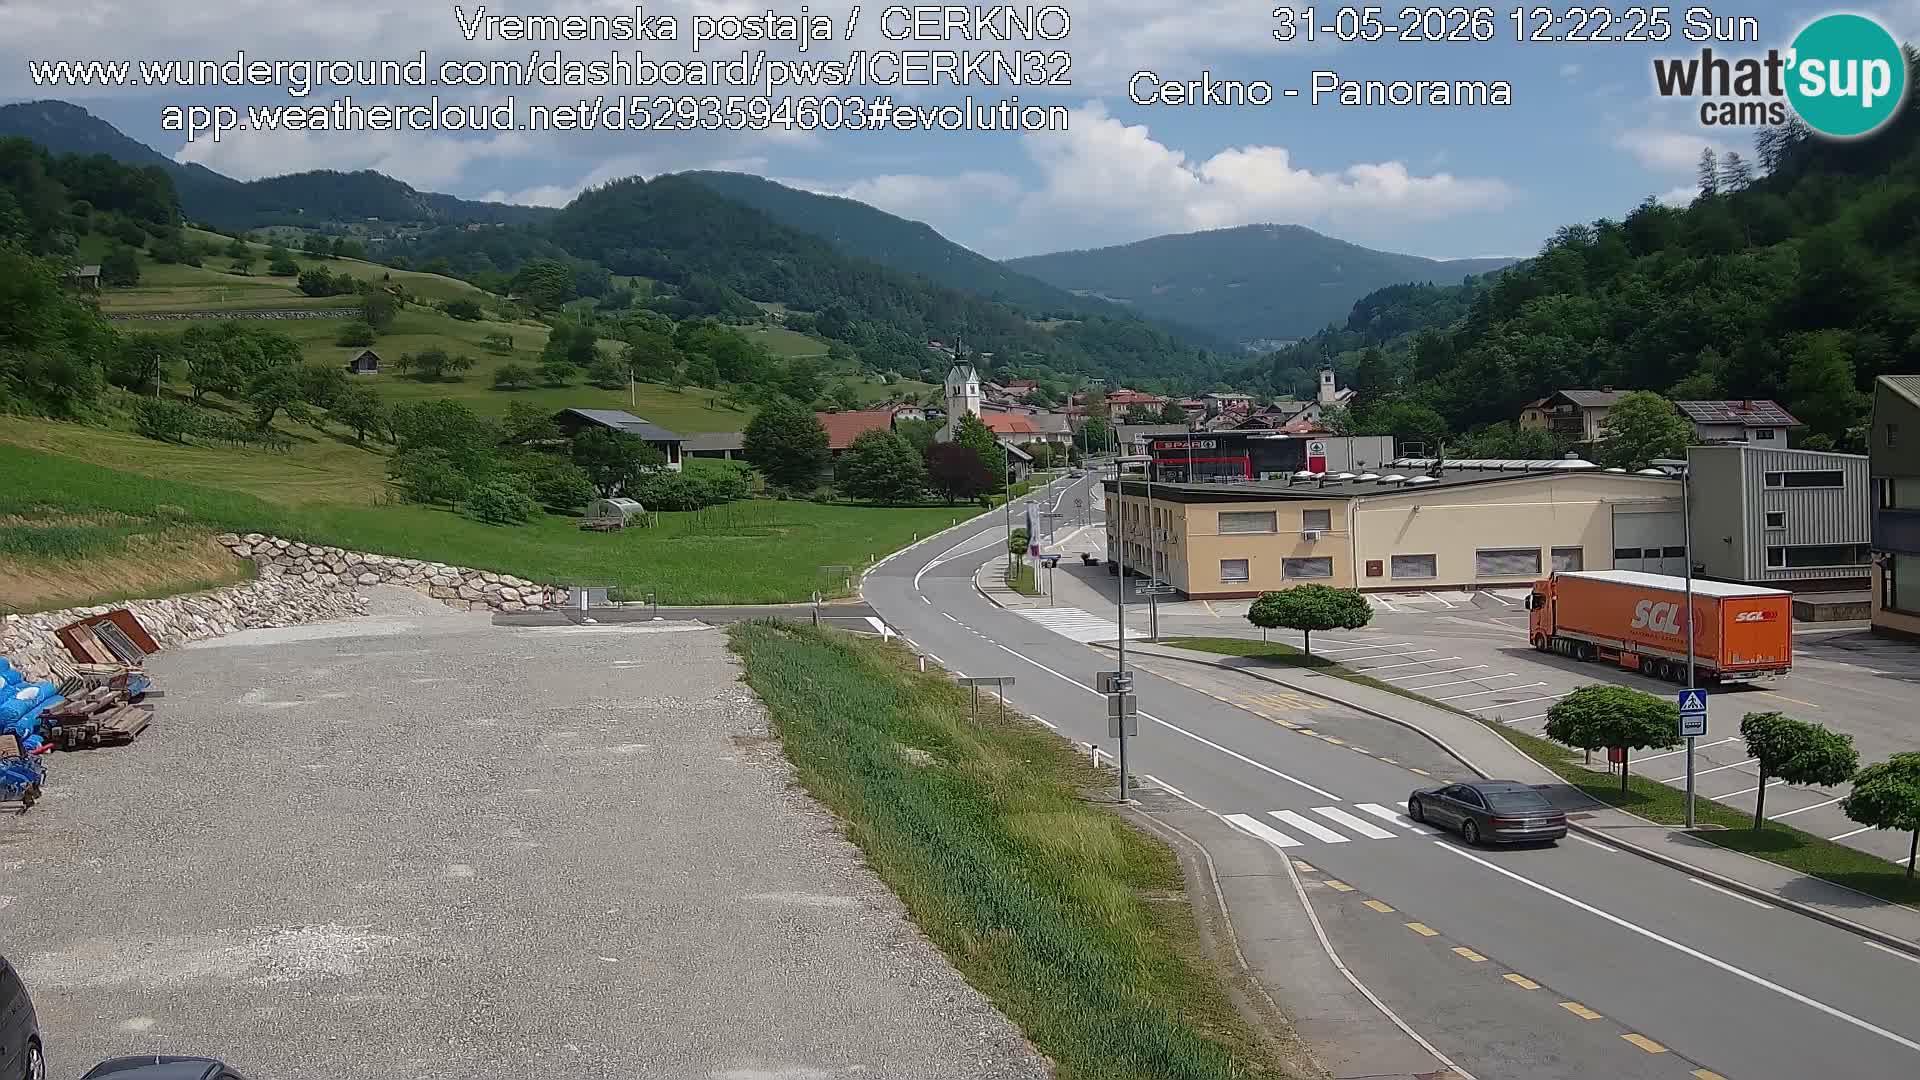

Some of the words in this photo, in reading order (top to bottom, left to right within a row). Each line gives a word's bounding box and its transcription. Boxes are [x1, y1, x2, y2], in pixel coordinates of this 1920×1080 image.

[1164, 441, 1201, 449] SPAR
[1631, 599, 1681, 635] SGL
[1735, 611, 1764, 621] SGL
